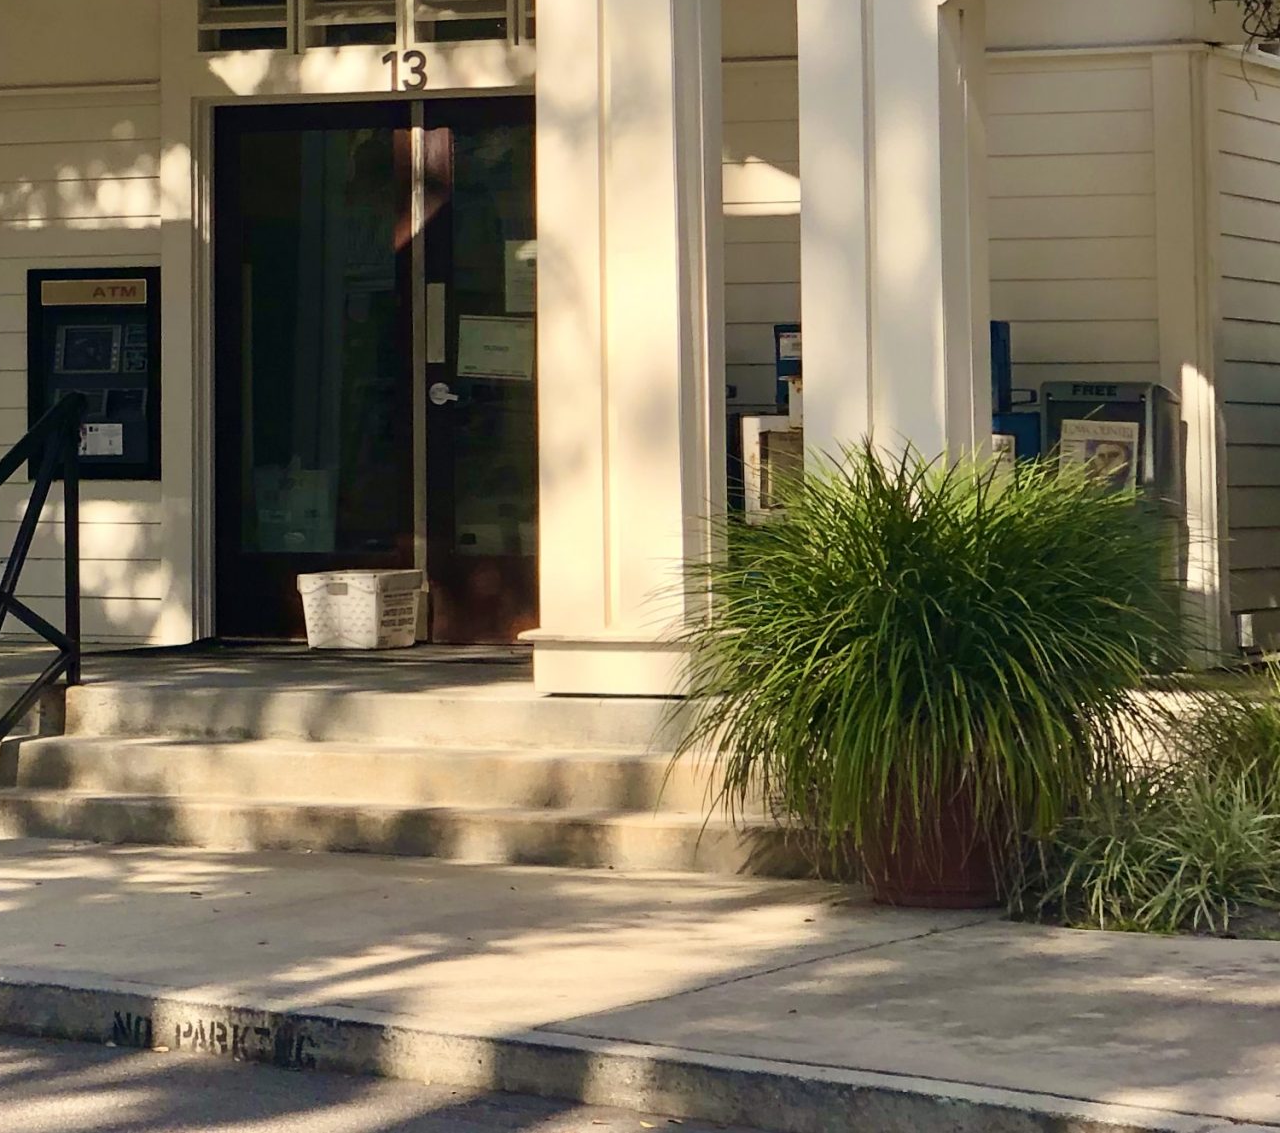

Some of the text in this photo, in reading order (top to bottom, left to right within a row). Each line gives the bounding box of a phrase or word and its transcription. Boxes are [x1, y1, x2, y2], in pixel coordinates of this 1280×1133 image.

[381, 49, 429, 92] 13
[92, 286, 137, 298] ATM
[1072, 383, 1118, 397] FREE
[113, 1010, 153, 1049] NO
